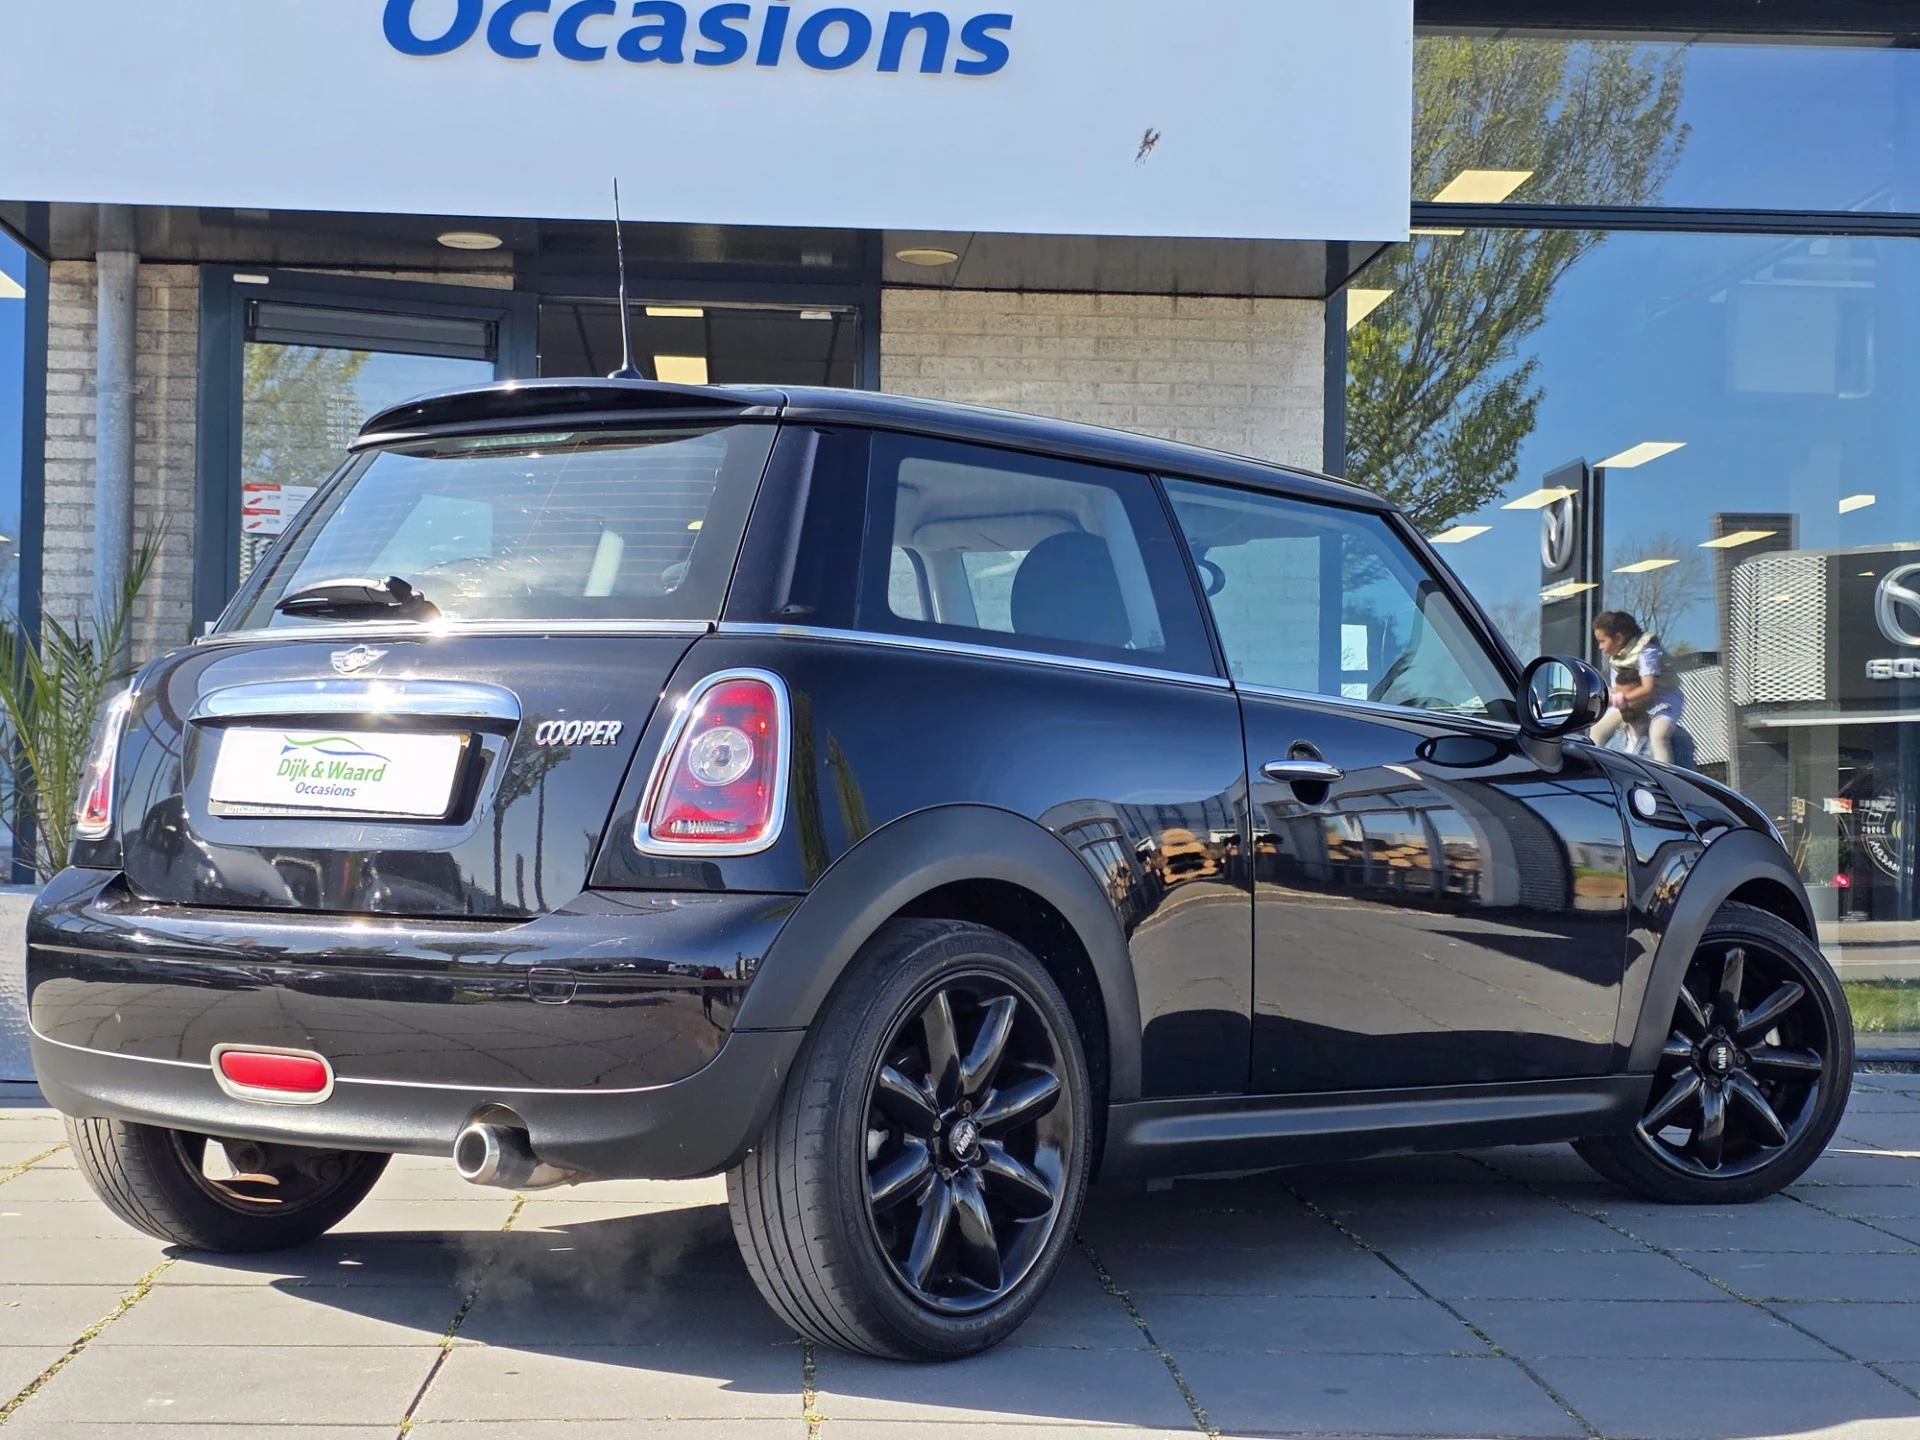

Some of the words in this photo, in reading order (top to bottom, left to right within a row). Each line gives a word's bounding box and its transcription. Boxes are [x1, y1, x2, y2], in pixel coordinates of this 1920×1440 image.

[382, 0, 1013, 77] Occasions
[535, 720, 624, 746] COOPER
[277, 758, 310, 781] Dijk
[311, 761, 325, 778] &
[327, 761, 387, 782] Waard
[295, 782, 357, 797] Occasions
[1717, 1047, 1727, 1069] MINI
[956, 1126, 974, 1156] MINI
